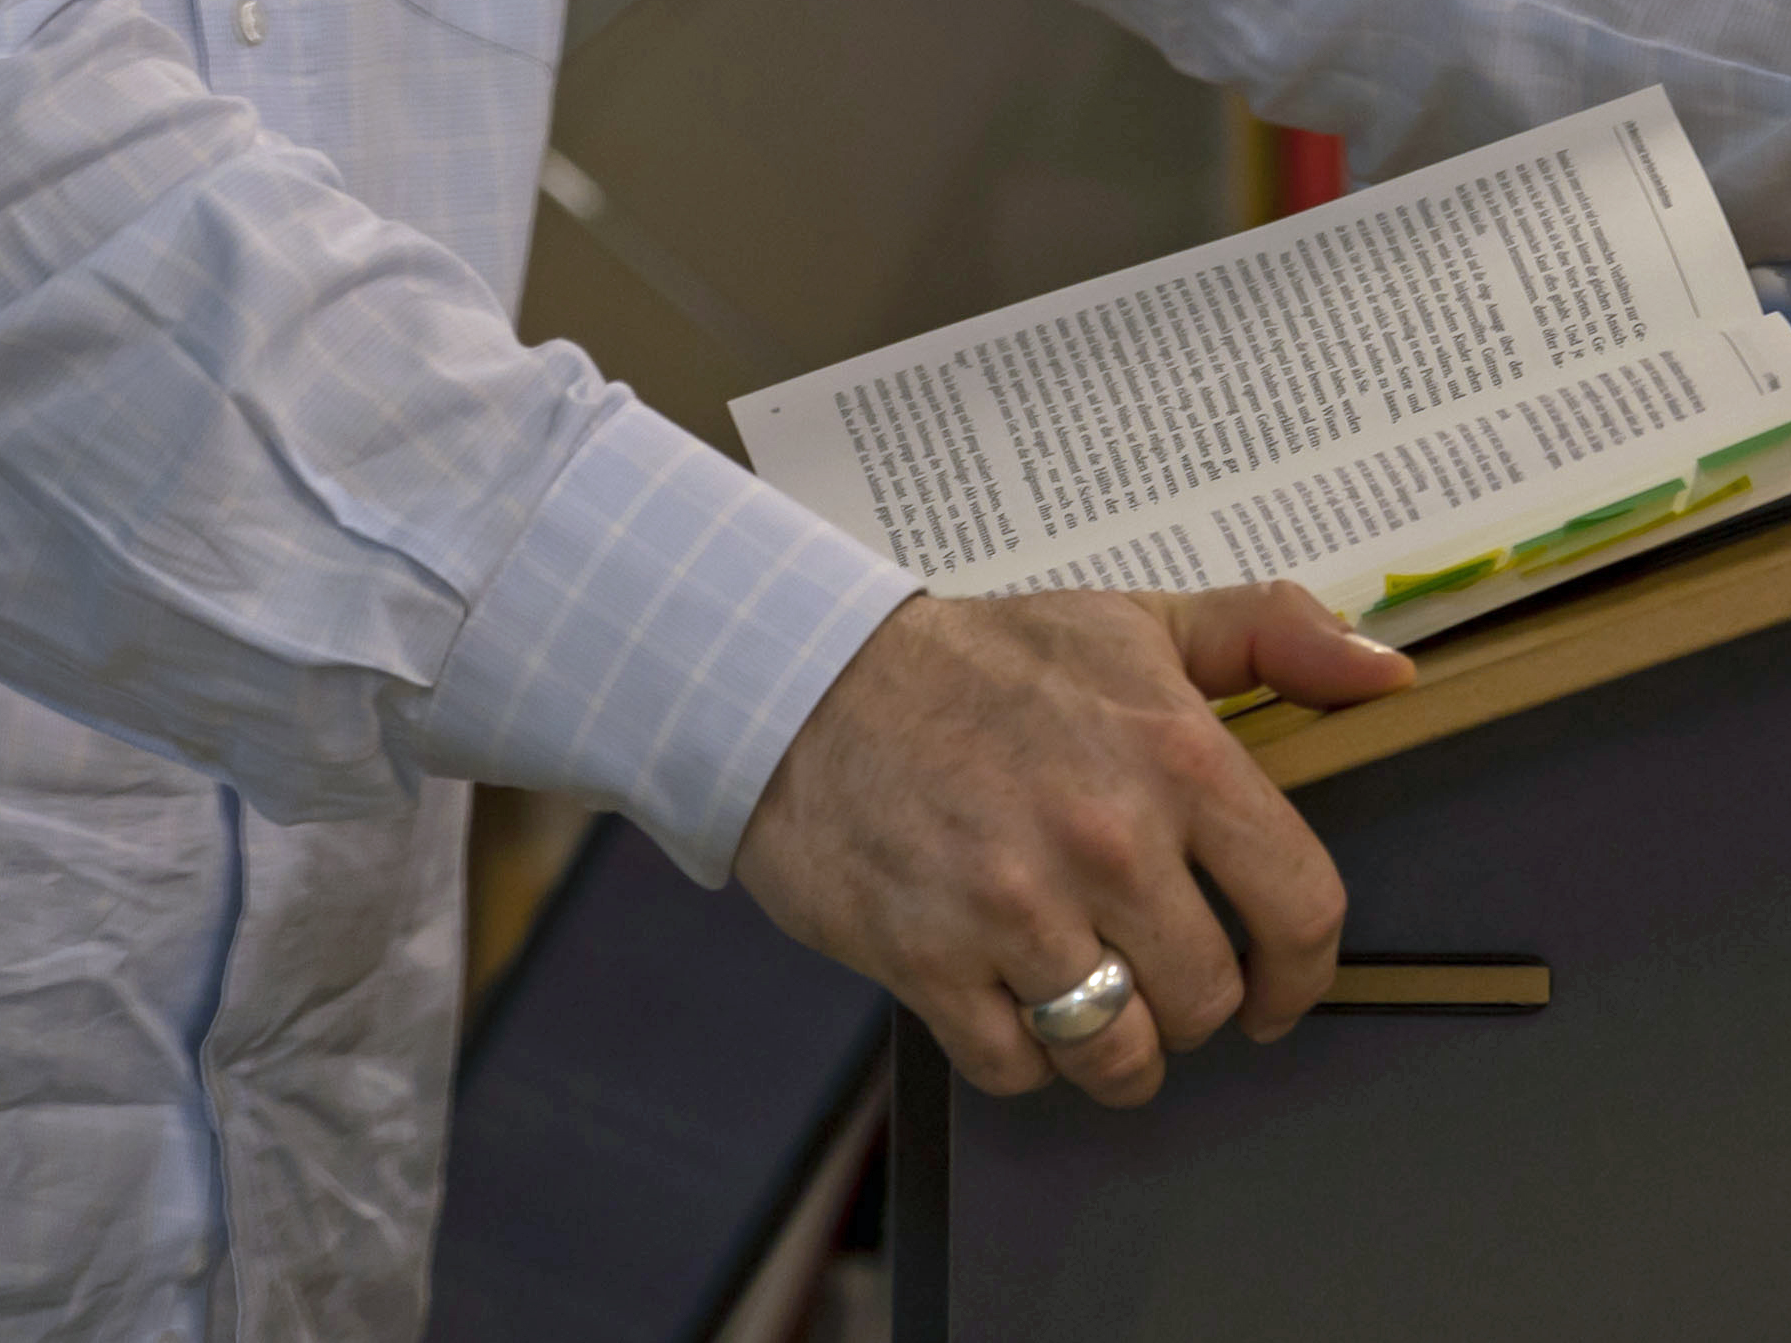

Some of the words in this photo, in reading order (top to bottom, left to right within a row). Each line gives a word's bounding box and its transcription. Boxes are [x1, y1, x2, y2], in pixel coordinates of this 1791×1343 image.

[1623, 305, 1638, 322] zur
[1562, 324, 1581, 346] Und
[1583, 320, 1600, 335] im
[1603, 311, 1629, 349] Ansich-
[1630, 321, 1649, 343] Ge-
[1540, 327, 1560, 351] öfter
[1550, 351, 1568, 370] ha-
[1568, 347, 1587, 360] je
[1590, 335, 1608, 356] Ge-
[1463, 364, 1485, 393] sehen
[1479, 346, 1507, 391] Gutmen-
[1507, 359, 1525, 379] den
[1418, 367, 1444, 407] Position
[1446, 378, 1465, 400] und
[1380, 389, 1405, 424] lassen,
[1405, 392, 1424, 414] und
[1319, 405, 1343, 441] Wissen
[1339, 398, 1363, 434] werden
[1253, 412, 1284, 465] Gedanken-
[1303, 424, 1324, 451] drin-
[1139, 472, 1154, 484] in
[1178, 454, 1199, 489] warum
[1199, 458, 1222, 483] geht
[1222, 457, 1239, 476] gar
[1159, 465, 1180, 499] waren.
[1075, 485, 1100, 523] Science
[1103, 496, 1120, 516] der
[1123, 489, 1142, 513] zwi-
[1144, 485, 1160, 506] ver-
[994, 512, 1013, 536] wird
[1036, 503, 1054, 521] ihn
[1062, 511, 1080, 530] ein
[952, 520, 979, 564] Muslime
[1043, 522, 1058, 540] na-
[1003, 536, 1021, 554] Ih-
[917, 551, 938, 578] auch
[940, 550, 960, 575] Ver-
